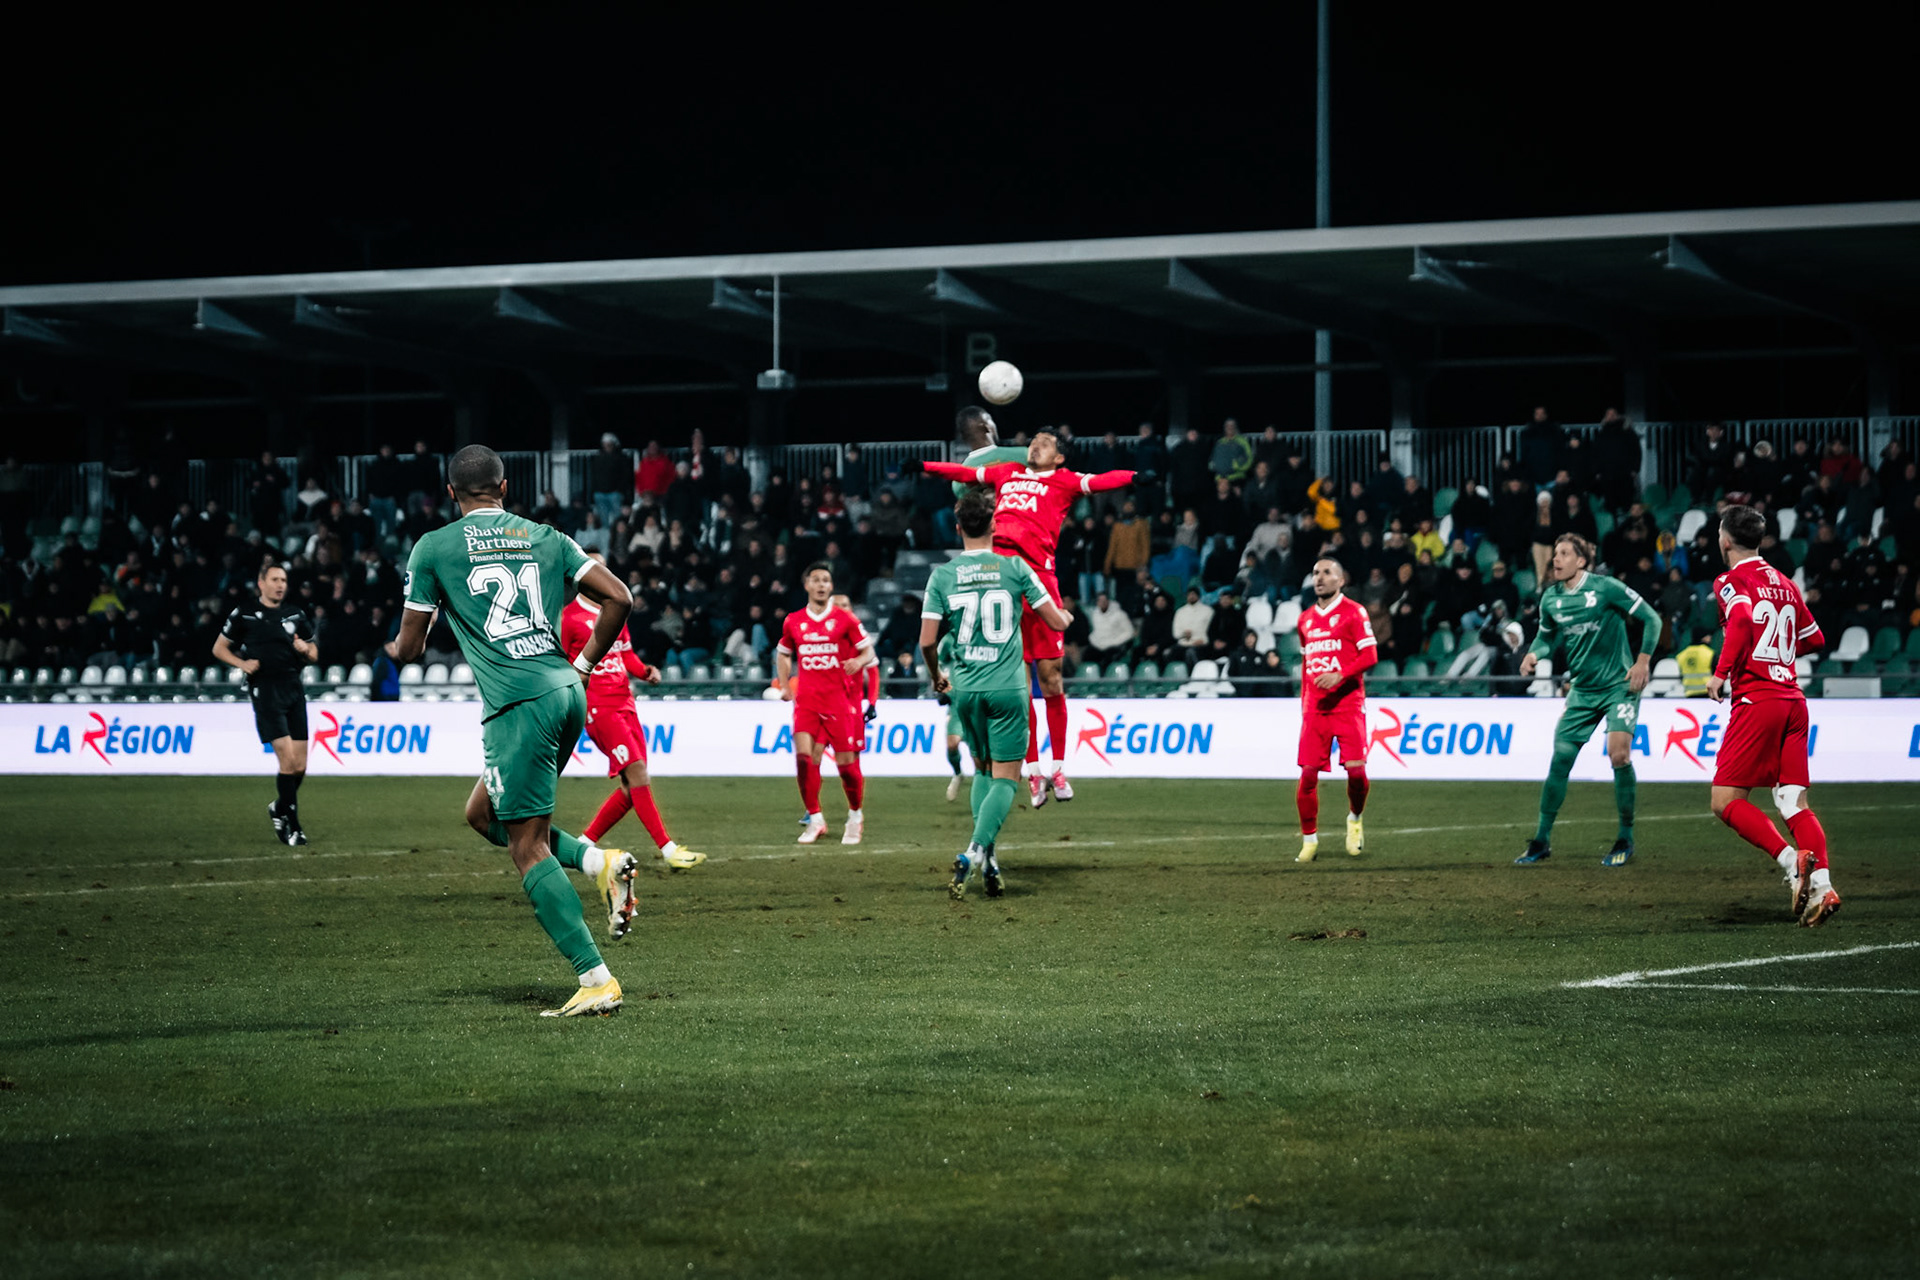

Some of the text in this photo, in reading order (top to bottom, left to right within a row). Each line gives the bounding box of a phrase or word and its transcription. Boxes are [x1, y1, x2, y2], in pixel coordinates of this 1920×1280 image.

[463, 525, 504, 538] Shaw
[465, 536, 532, 552] Partners
[469, 552, 533, 563] Financial Services
[466, 562, 552, 642] 21
[947, 589, 1014, 645] 70
[1752, 599, 1797, 666] 20
[801, 655, 840, 671] CCSA
[35, 711, 194, 766] LA RÉGION
[311, 710, 431, 766] RÉGION
[611, 744, 630, 765] 19
[1075, 708, 1213, 767] RÉGION
[1367, 707, 1513, 768] RÉGION
